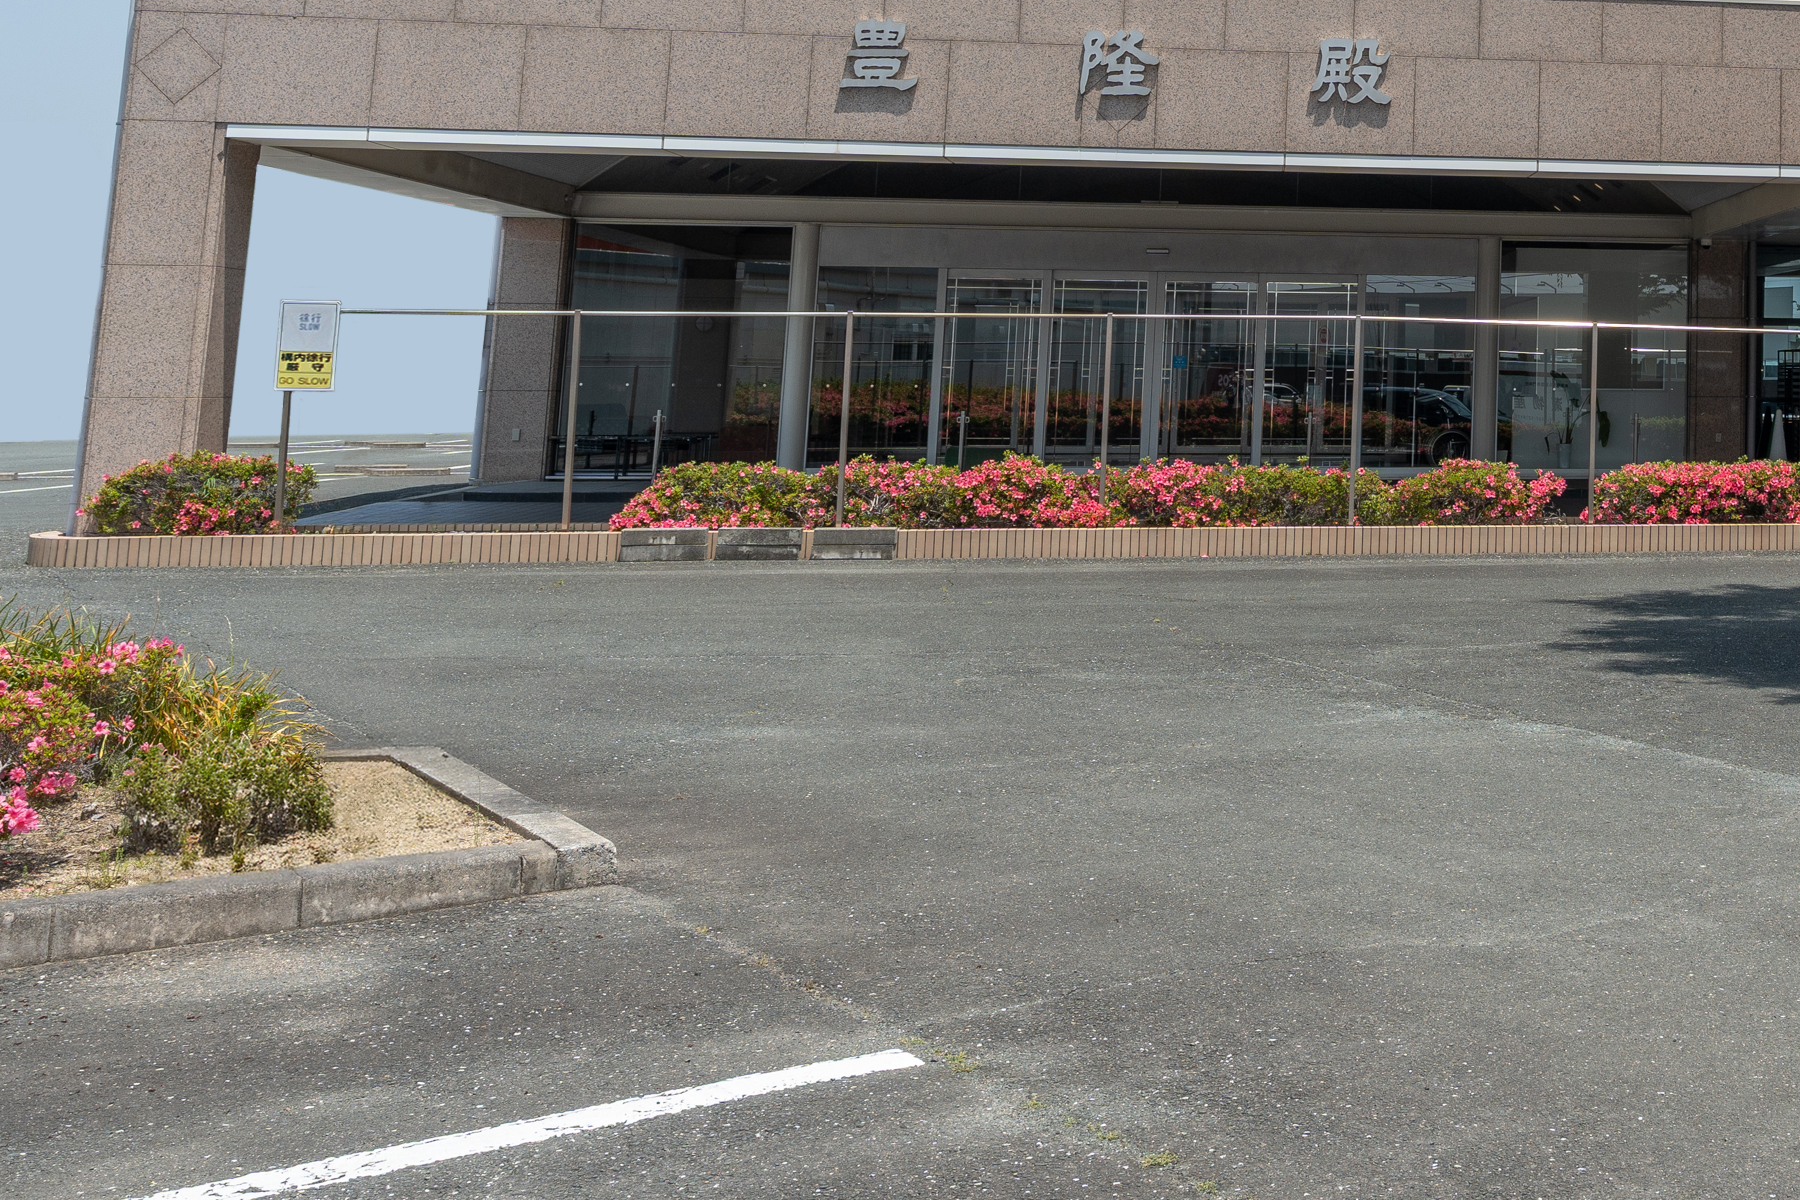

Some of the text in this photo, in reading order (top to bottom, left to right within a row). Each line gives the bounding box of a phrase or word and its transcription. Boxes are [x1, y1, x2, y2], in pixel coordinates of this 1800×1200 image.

[839, 18, 1391, 104] 豊隆殿
[299, 313, 321, 323] 徐行
[299, 323, 320, 331] SLOW
[281, 353, 332, 362] 構内徐行
[279, 377, 329, 385] GO SLOW
